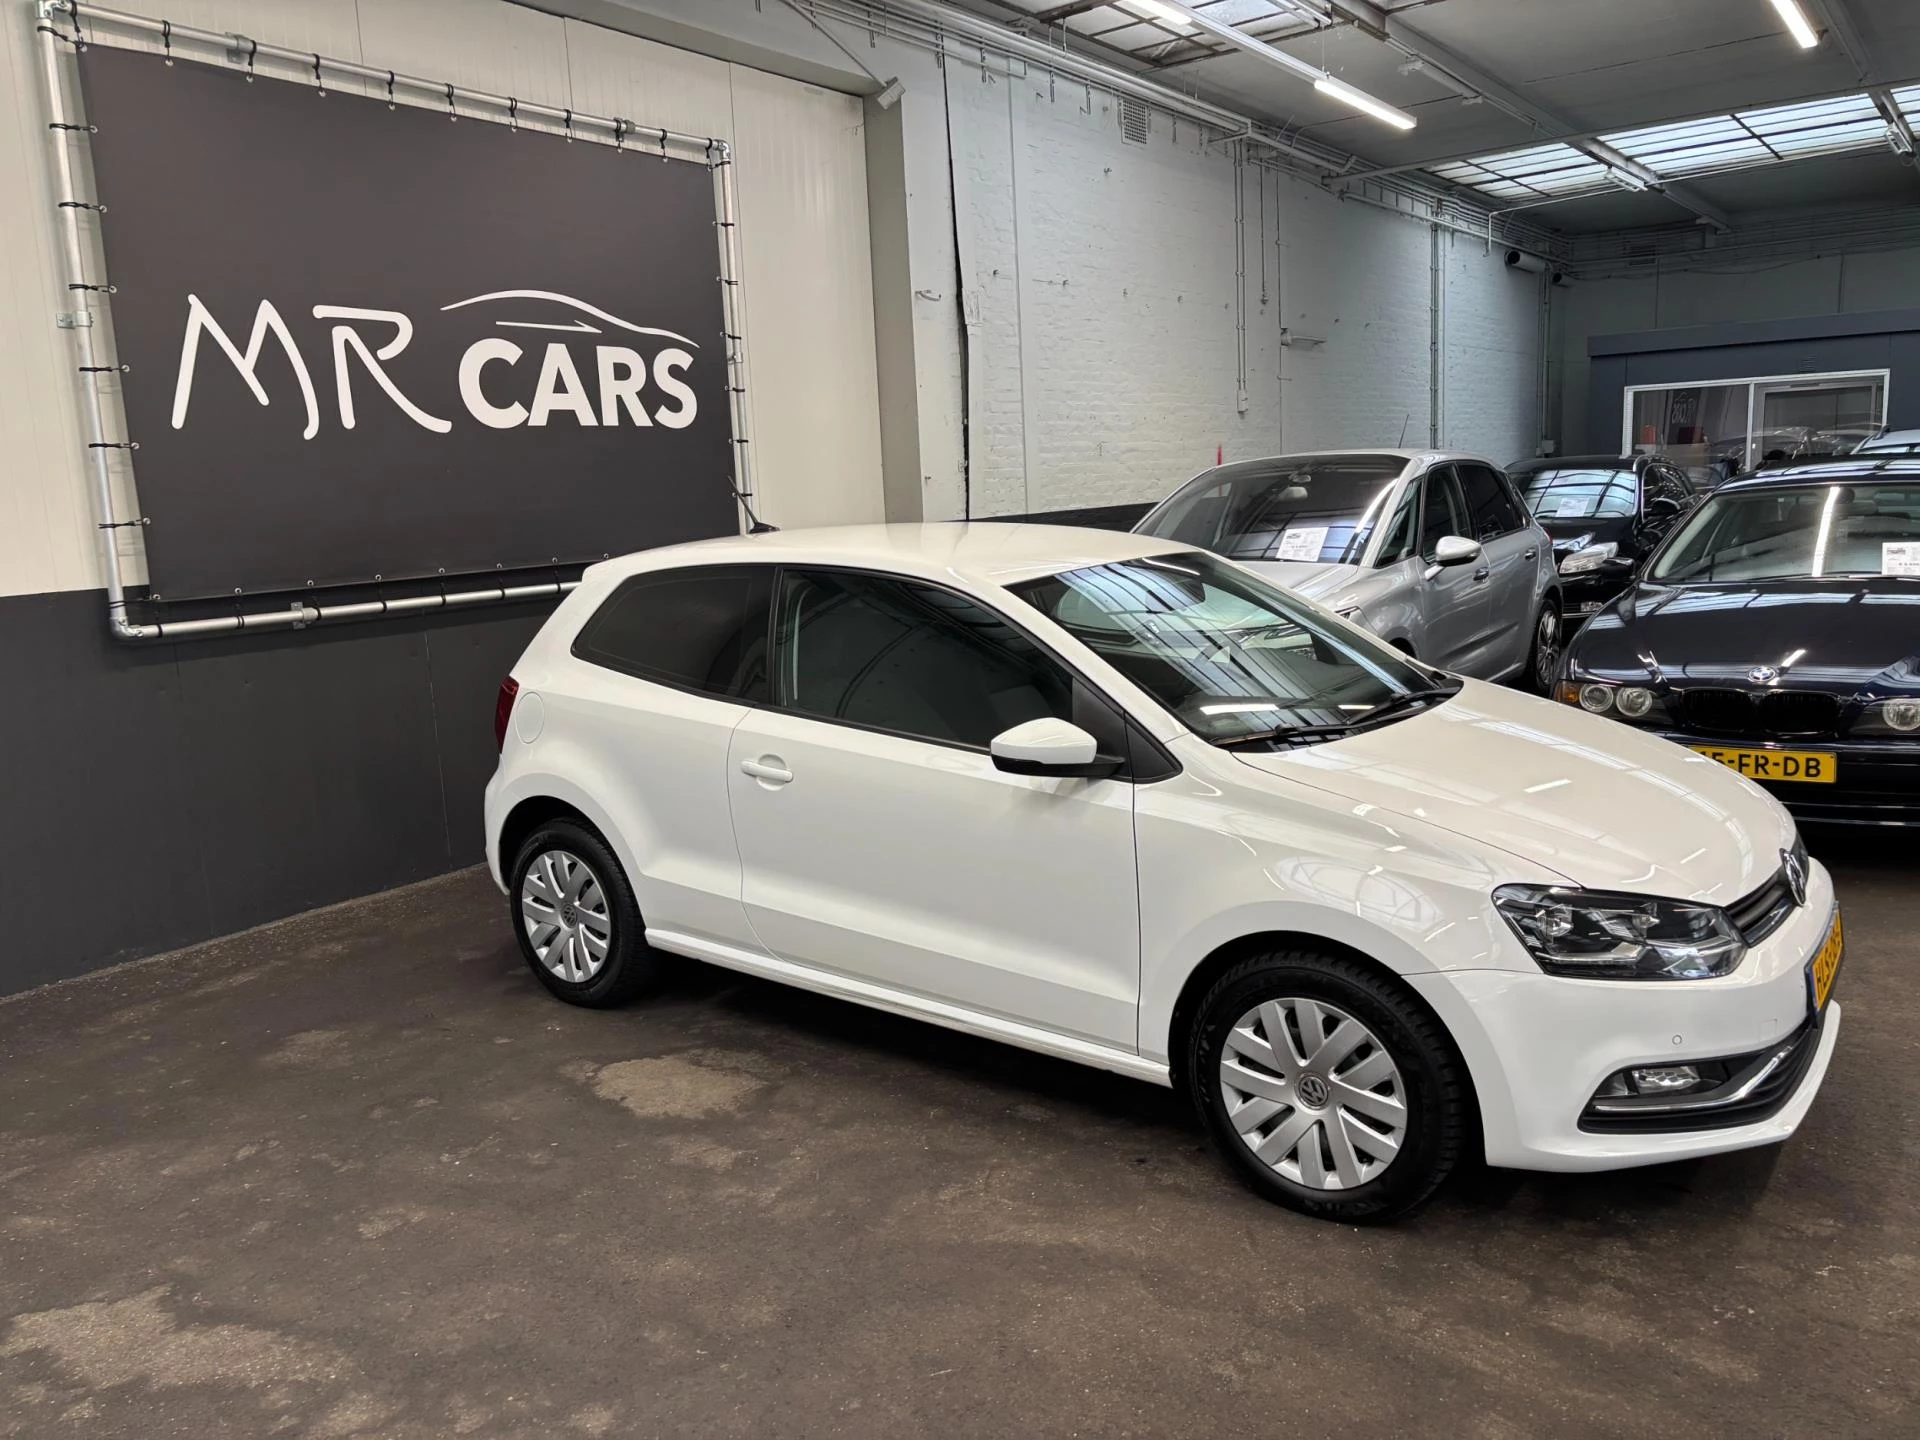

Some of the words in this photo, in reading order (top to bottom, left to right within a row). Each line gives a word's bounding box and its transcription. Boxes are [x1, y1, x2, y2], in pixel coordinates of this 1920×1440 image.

[172, 294, 452, 440] MR
[458, 338, 698, 429] CARS
[1700, 750, 1821, 778] 5-FR-DB
